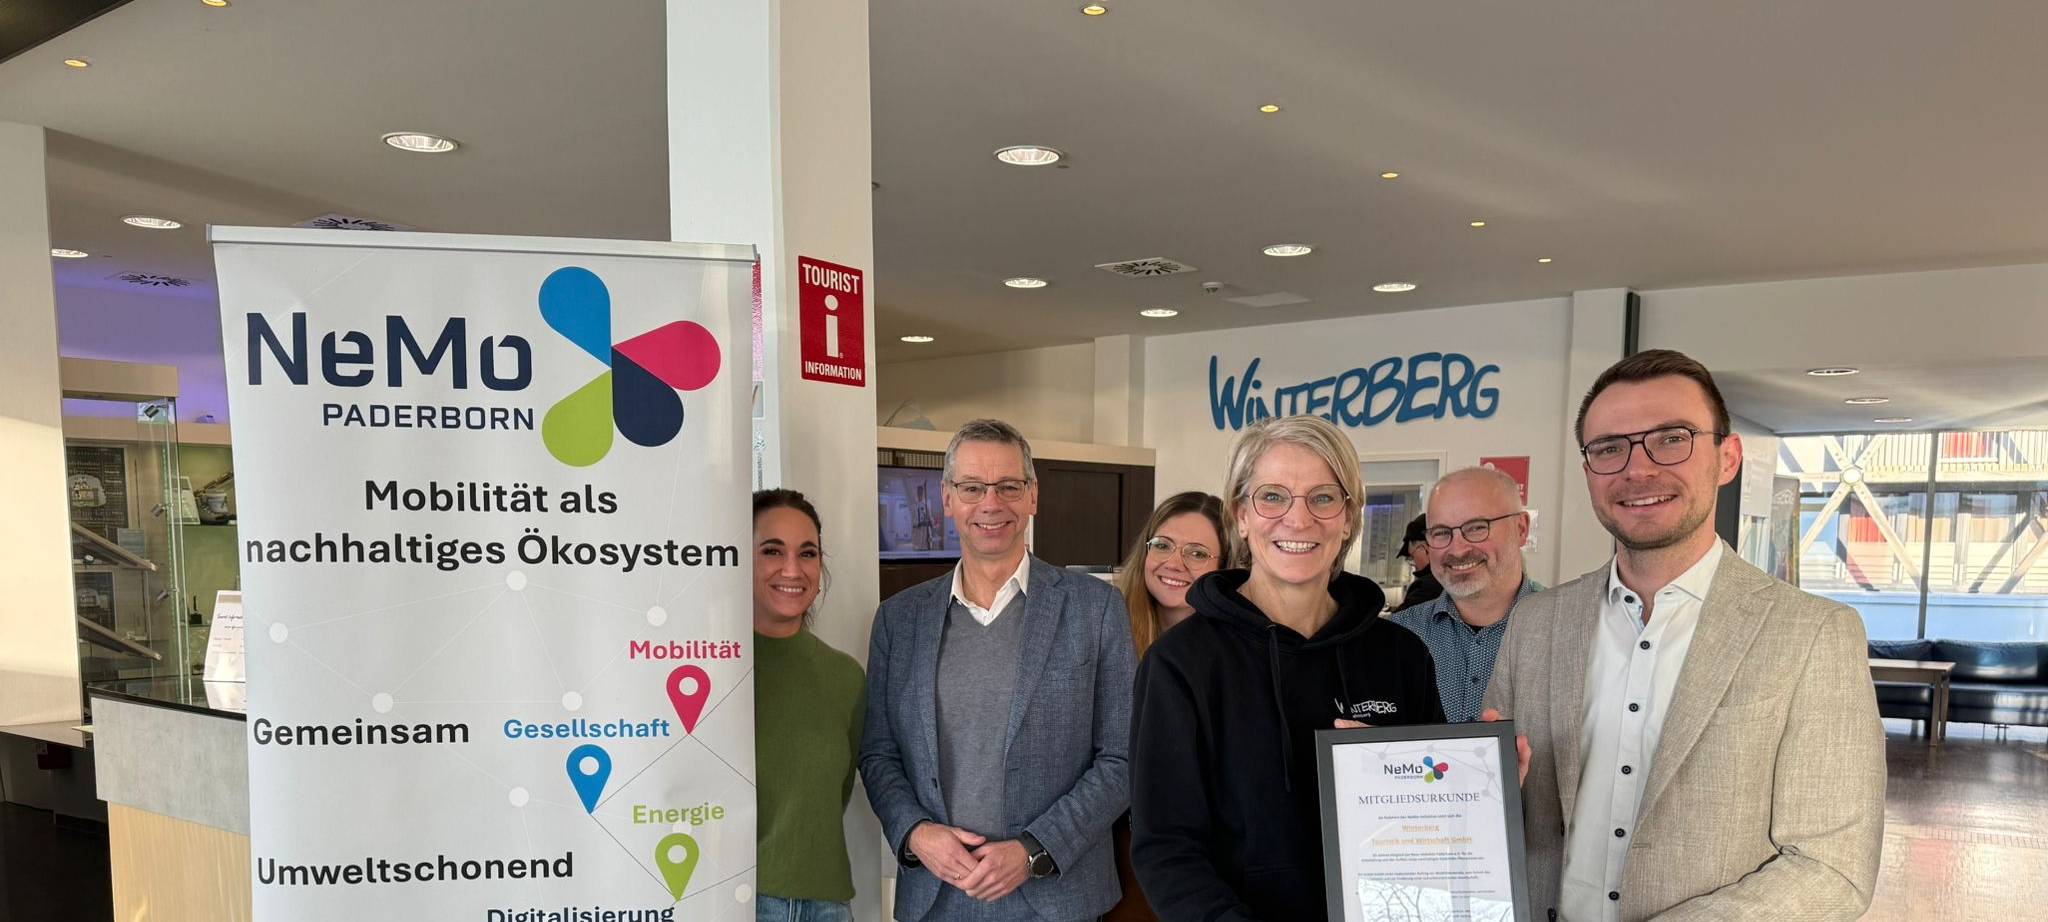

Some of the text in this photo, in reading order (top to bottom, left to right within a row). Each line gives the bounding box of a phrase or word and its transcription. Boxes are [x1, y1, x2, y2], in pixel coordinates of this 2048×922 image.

[802, 263, 860, 295] TOURIST
[246, 311, 533, 392] NeMo
[804, 360, 862, 381] INFORMATION
[322, 403, 535, 431] PADERBORN
[364, 480, 619, 515] Mobilität als
[245, 527, 740, 573] nachhaltiges Ökosystem
[628, 639, 742, 661] Mobilität
[252, 717, 471, 747] Gemeinsam
[503, 718, 671, 741] Gesellschaft
[1383, 763, 1424, 775] NeMo
[1358, 792, 1481, 806] MITGLIEDSURKUNDE
[632, 803, 726, 829] Energie
[257, 852, 575, 886] Umweltschonend
